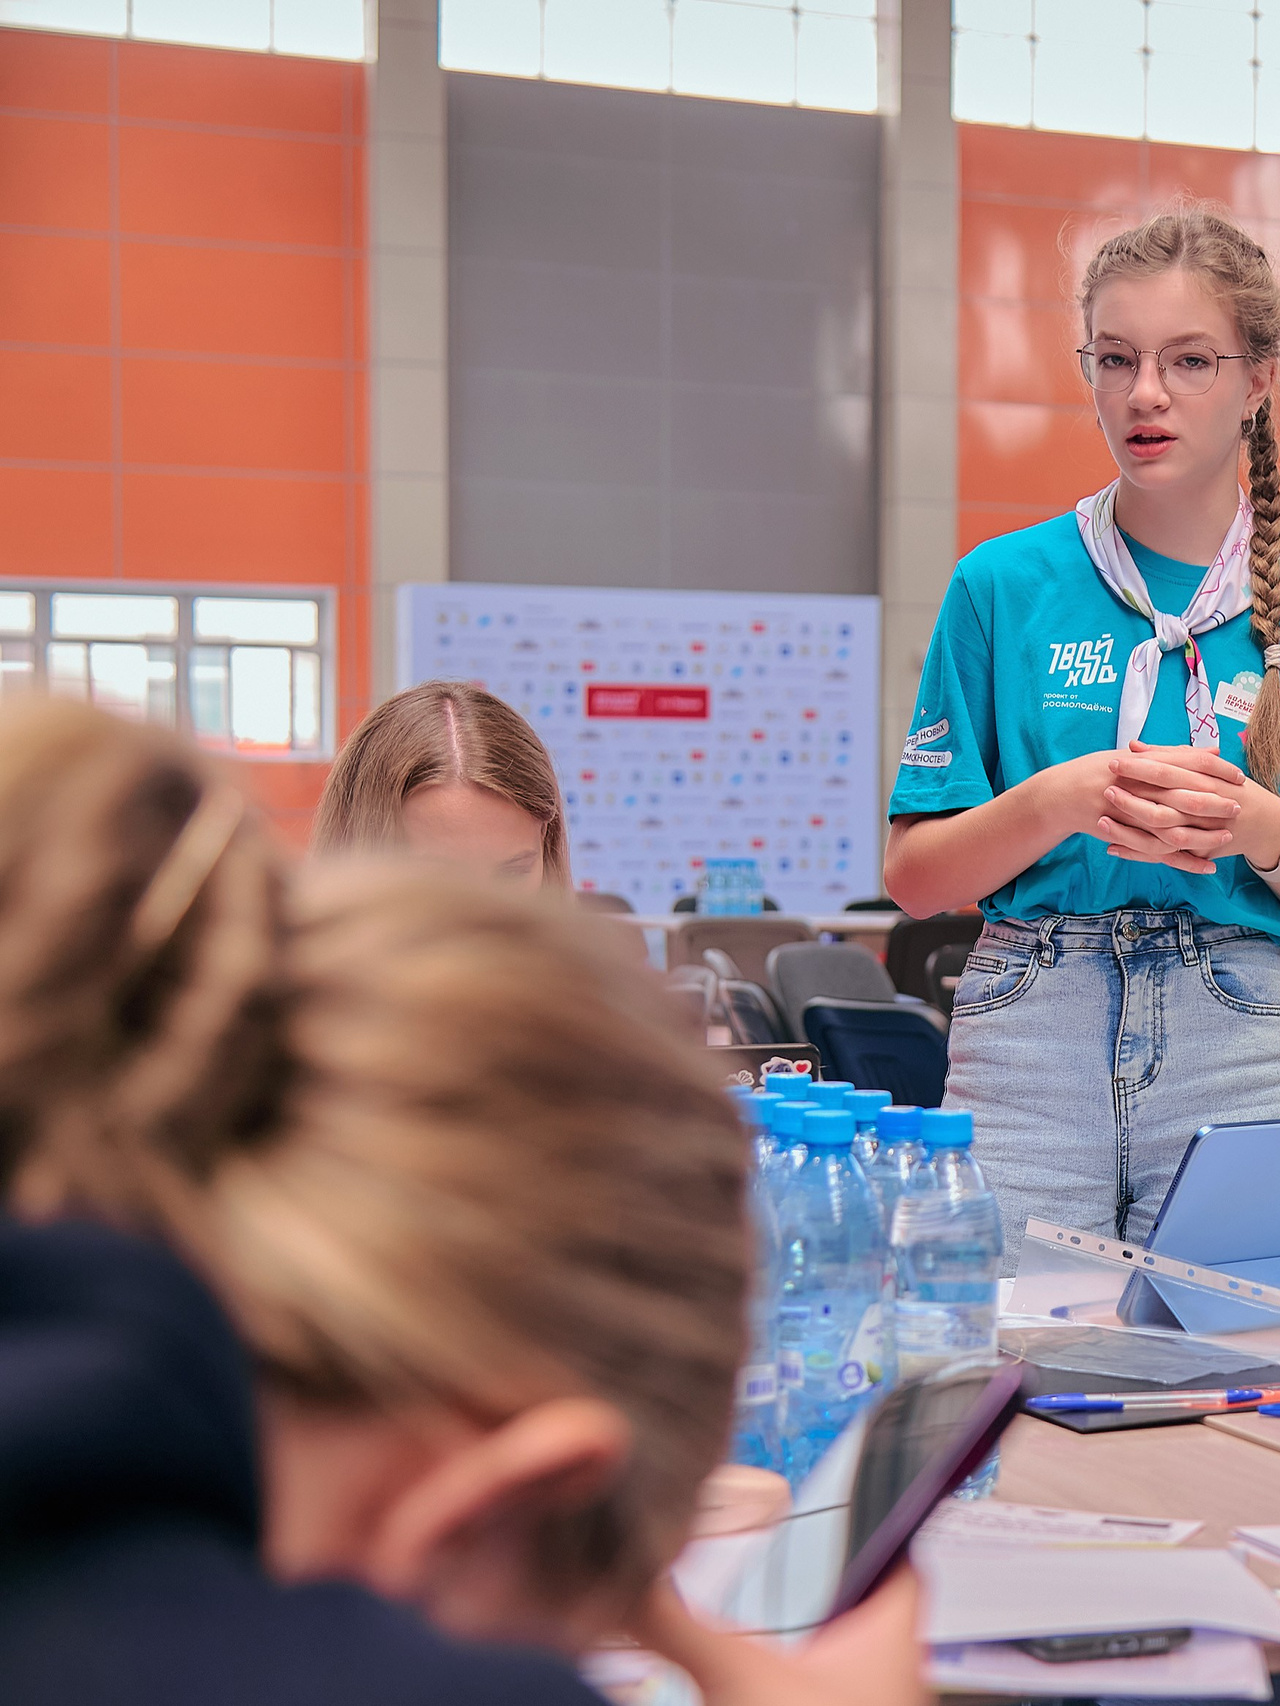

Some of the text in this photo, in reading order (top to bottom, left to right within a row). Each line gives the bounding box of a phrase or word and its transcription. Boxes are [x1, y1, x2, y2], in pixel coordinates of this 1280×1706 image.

[1042, 701, 1113, 713] росмолодёжь
[1225, 699, 1253, 713] ПЕРЕМЕ
[1227, 694, 1255, 708] БОЛЬШ
